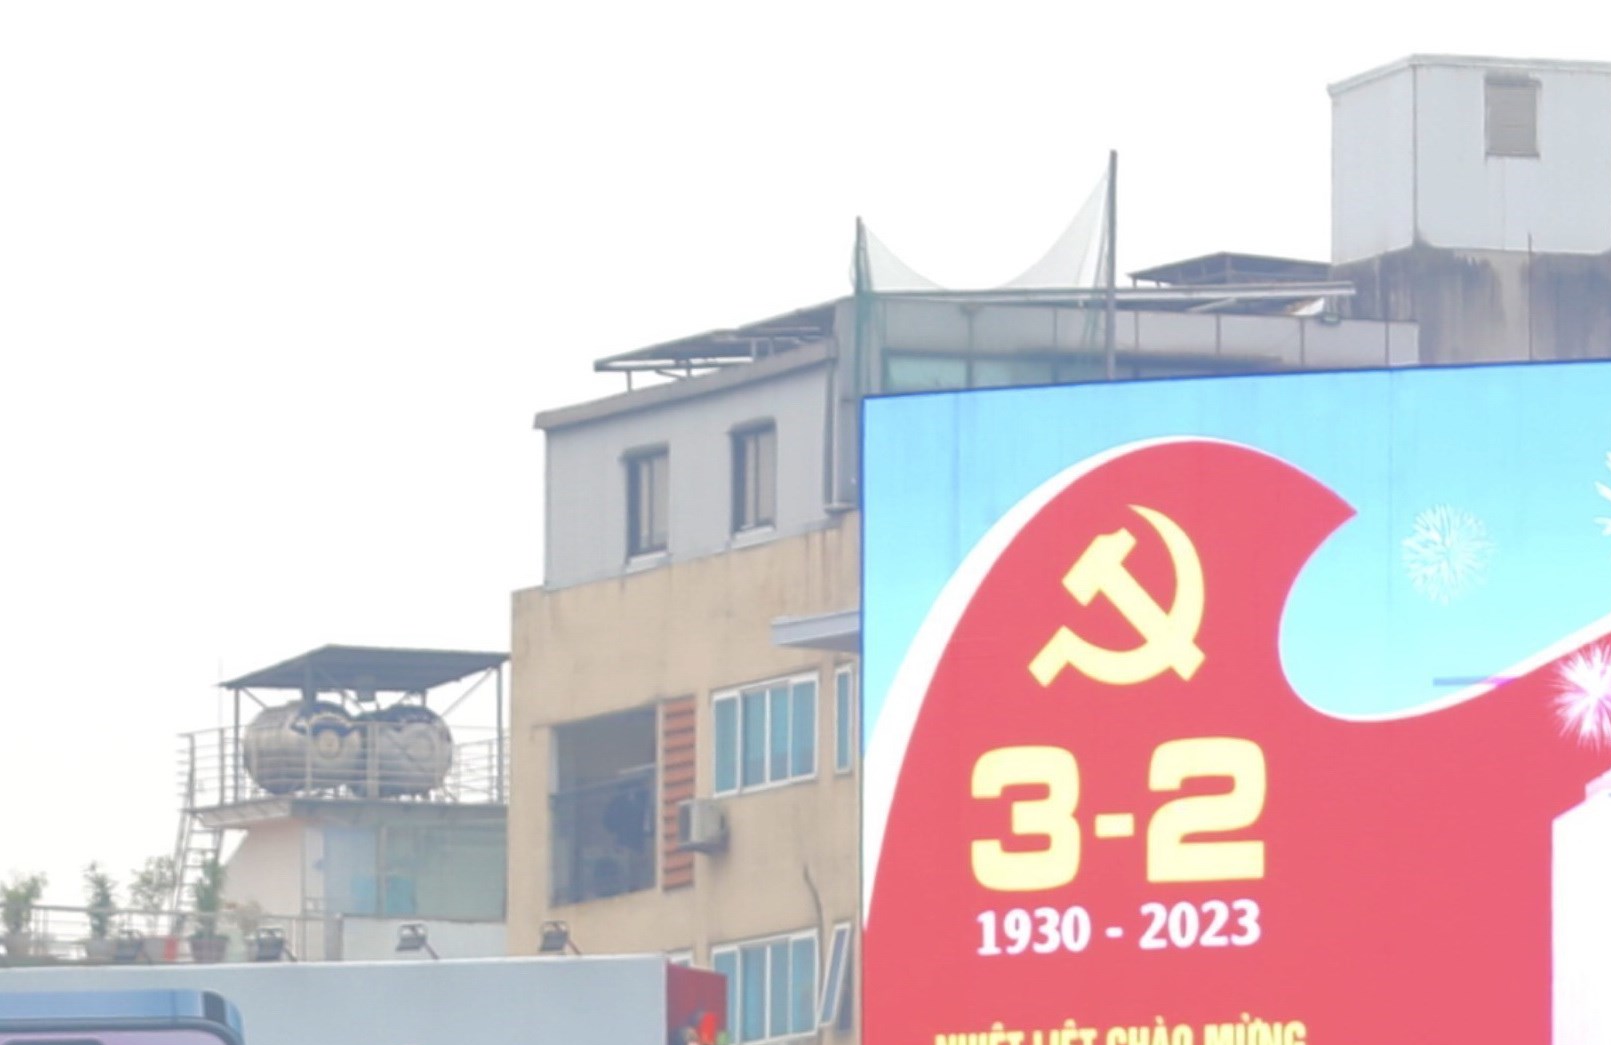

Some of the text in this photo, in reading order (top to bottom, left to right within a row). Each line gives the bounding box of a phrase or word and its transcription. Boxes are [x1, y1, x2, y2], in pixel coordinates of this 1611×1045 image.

[970, 736, 1268, 892] 3-2
[976, 905, 1092, 956] 1930
[1138, 898, 1262, 950] 2023
